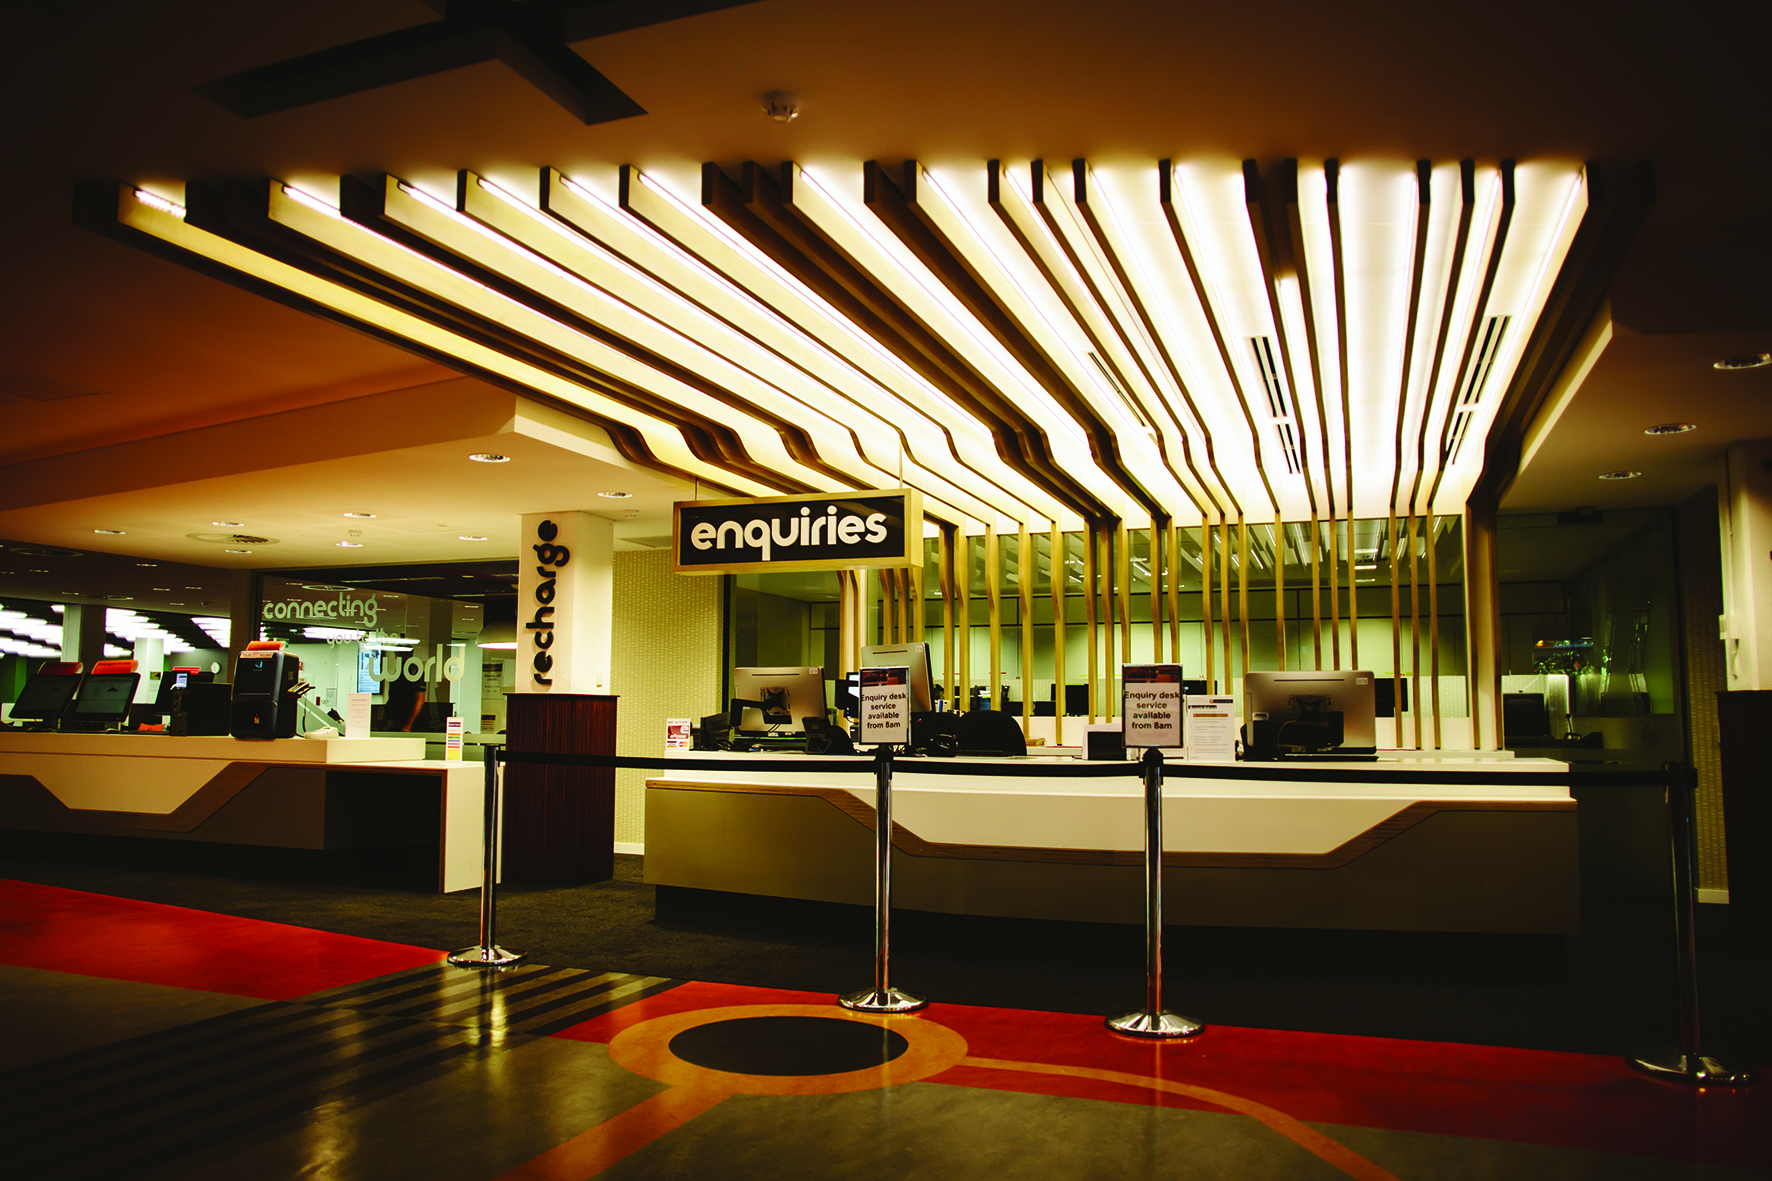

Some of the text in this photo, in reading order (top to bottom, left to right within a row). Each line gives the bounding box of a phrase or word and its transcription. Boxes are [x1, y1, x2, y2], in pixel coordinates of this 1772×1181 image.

[690, 505, 887, 561] enquiries
[263, 592, 378, 627] connecting
[525, 520, 570, 685] recharge
[326, 633, 352, 649] you
[368, 644, 466, 682] world
[861, 692, 907, 702] Enquiry desk
[1125, 691, 1180, 700] Enquiry desk
[867, 712, 900, 720] available
[1132, 711, 1171, 719] available
